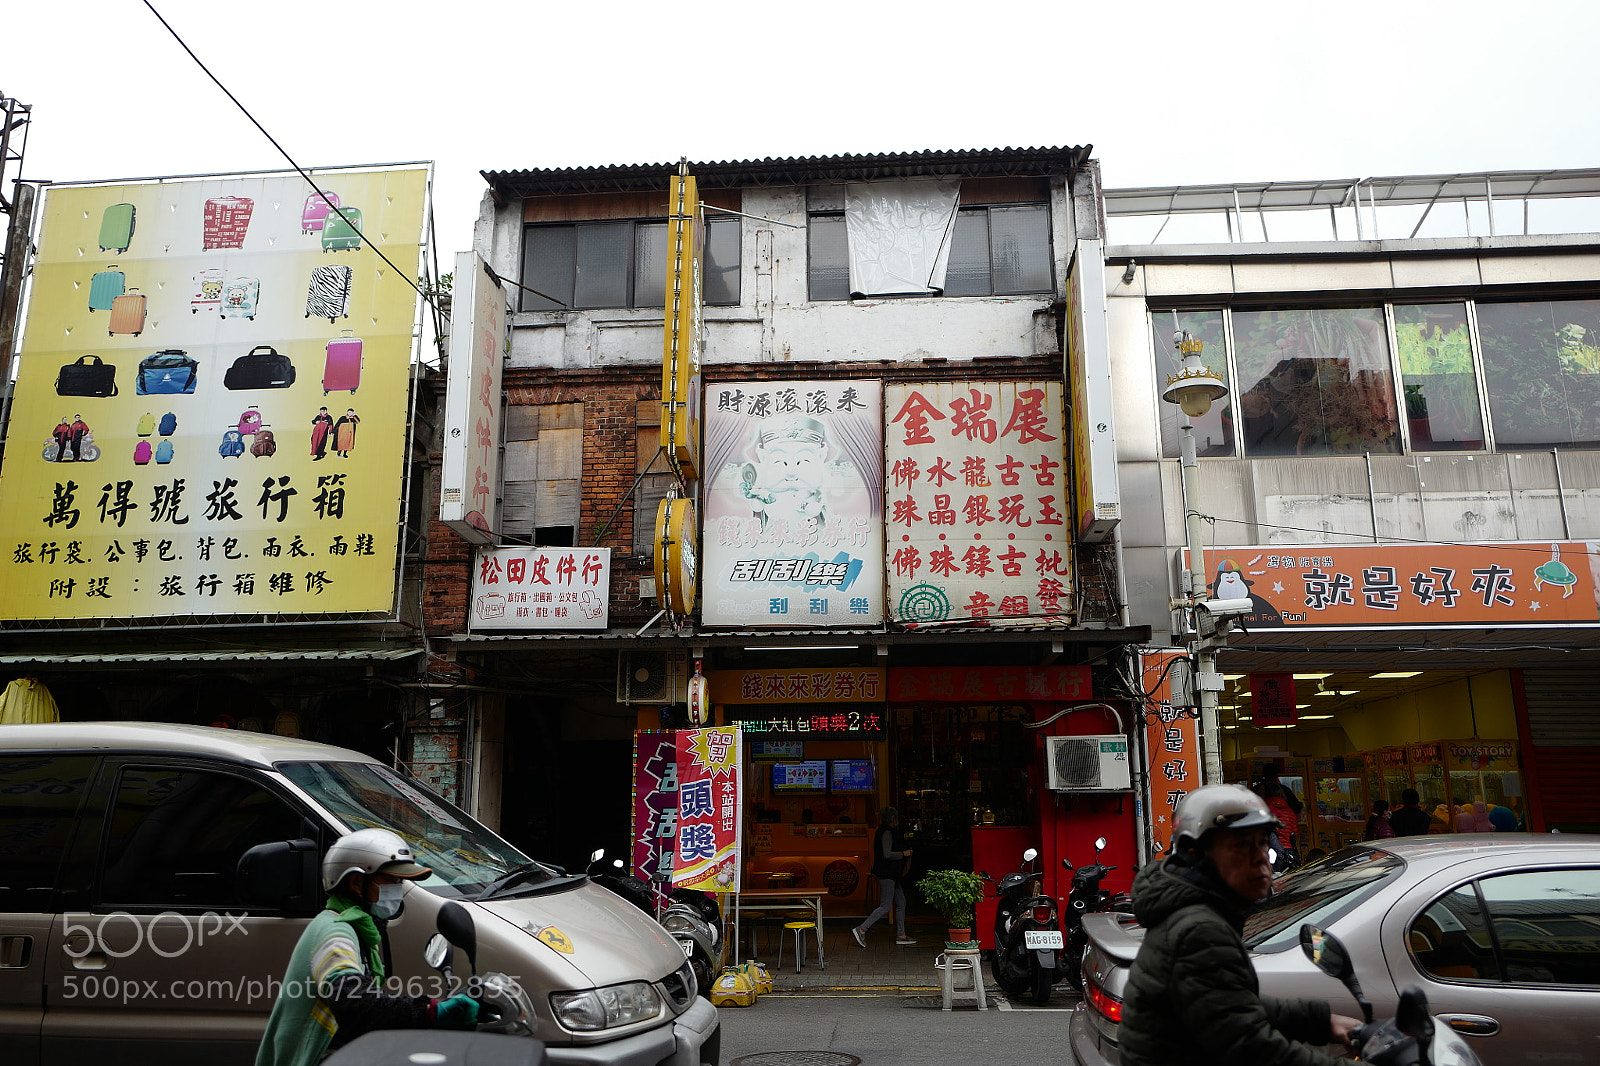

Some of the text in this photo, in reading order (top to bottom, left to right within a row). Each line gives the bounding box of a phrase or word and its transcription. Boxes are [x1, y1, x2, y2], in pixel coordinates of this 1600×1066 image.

[891, 388, 1058, 446] 金瑞展
[43, 473, 348, 530] 萬得號旅行箱
[480, 553, 603, 586] 松田皮件行
[730, 559, 849, 586] 刮刮樂
[1301, 563, 1517, 610] 就是好夾
[741, 671, 879, 700] 錢來來彩券行
[896, 671, 1084, 698] 金瑞展古玩行
[706, 730, 734, 764] 賀
[680, 778, 716, 863] 頭獎
[721, 780, 735, 832] 本站開出
